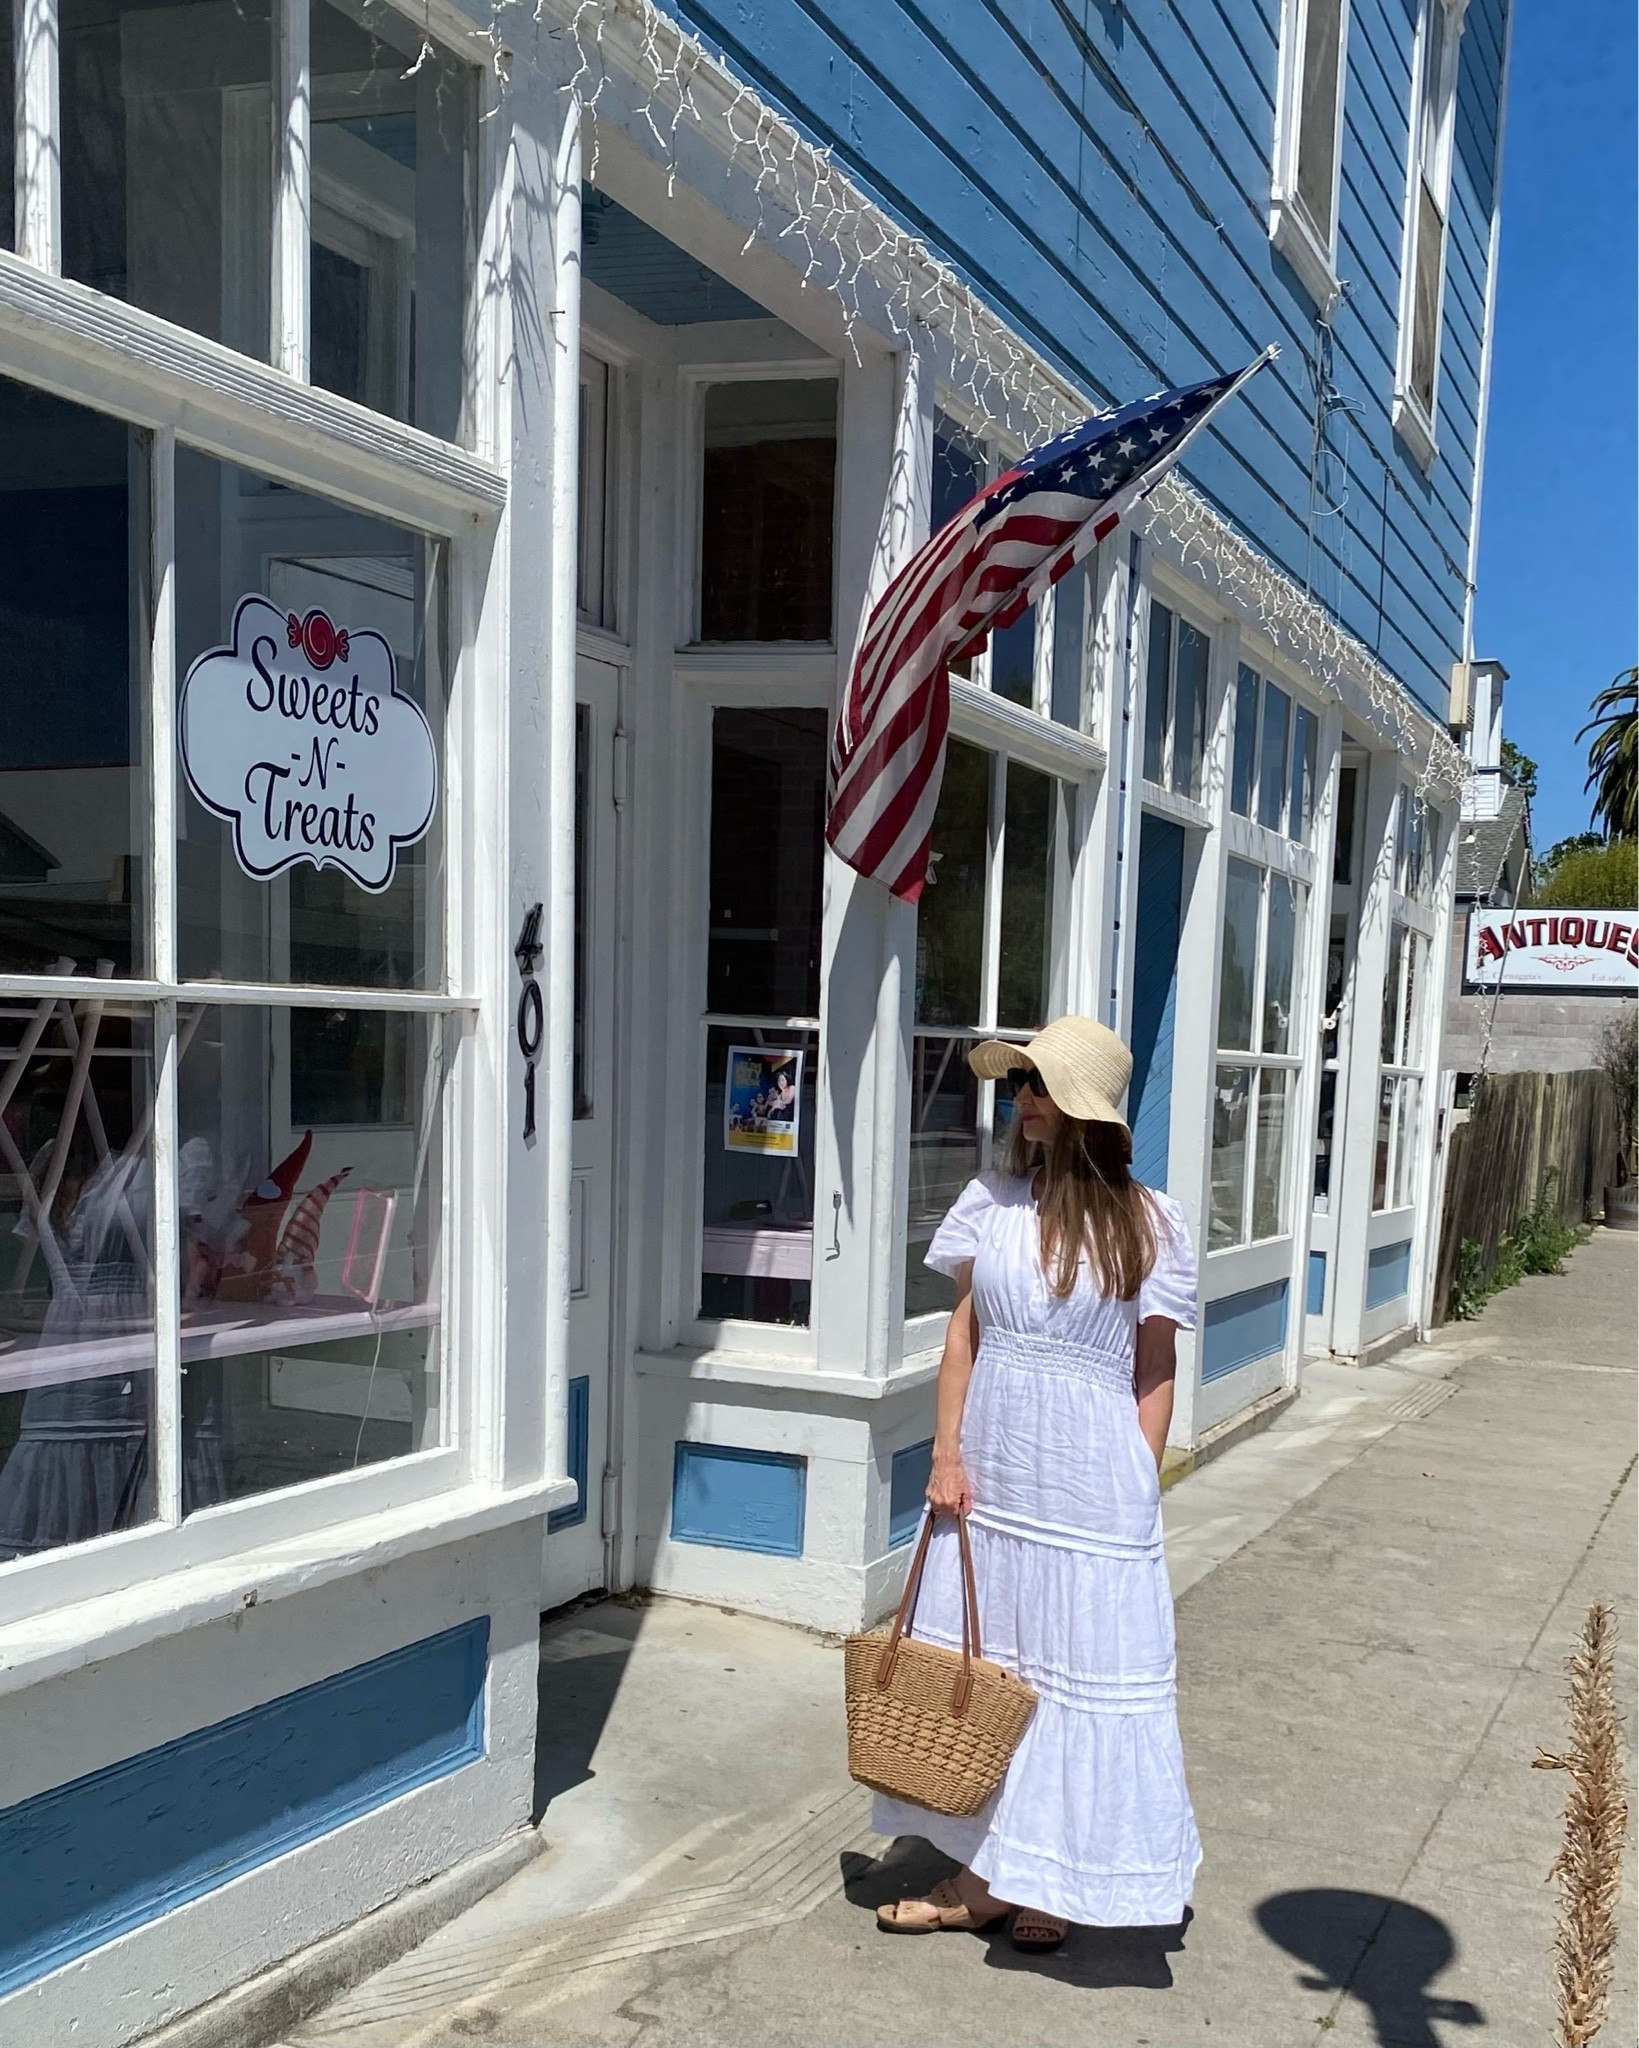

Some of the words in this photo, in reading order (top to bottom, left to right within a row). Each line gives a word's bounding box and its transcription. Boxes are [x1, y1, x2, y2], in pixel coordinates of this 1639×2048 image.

[246, 634, 380, 736] Sweets
[244, 761, 376, 852] Treats
[514, 902, 544, 1139] 401
